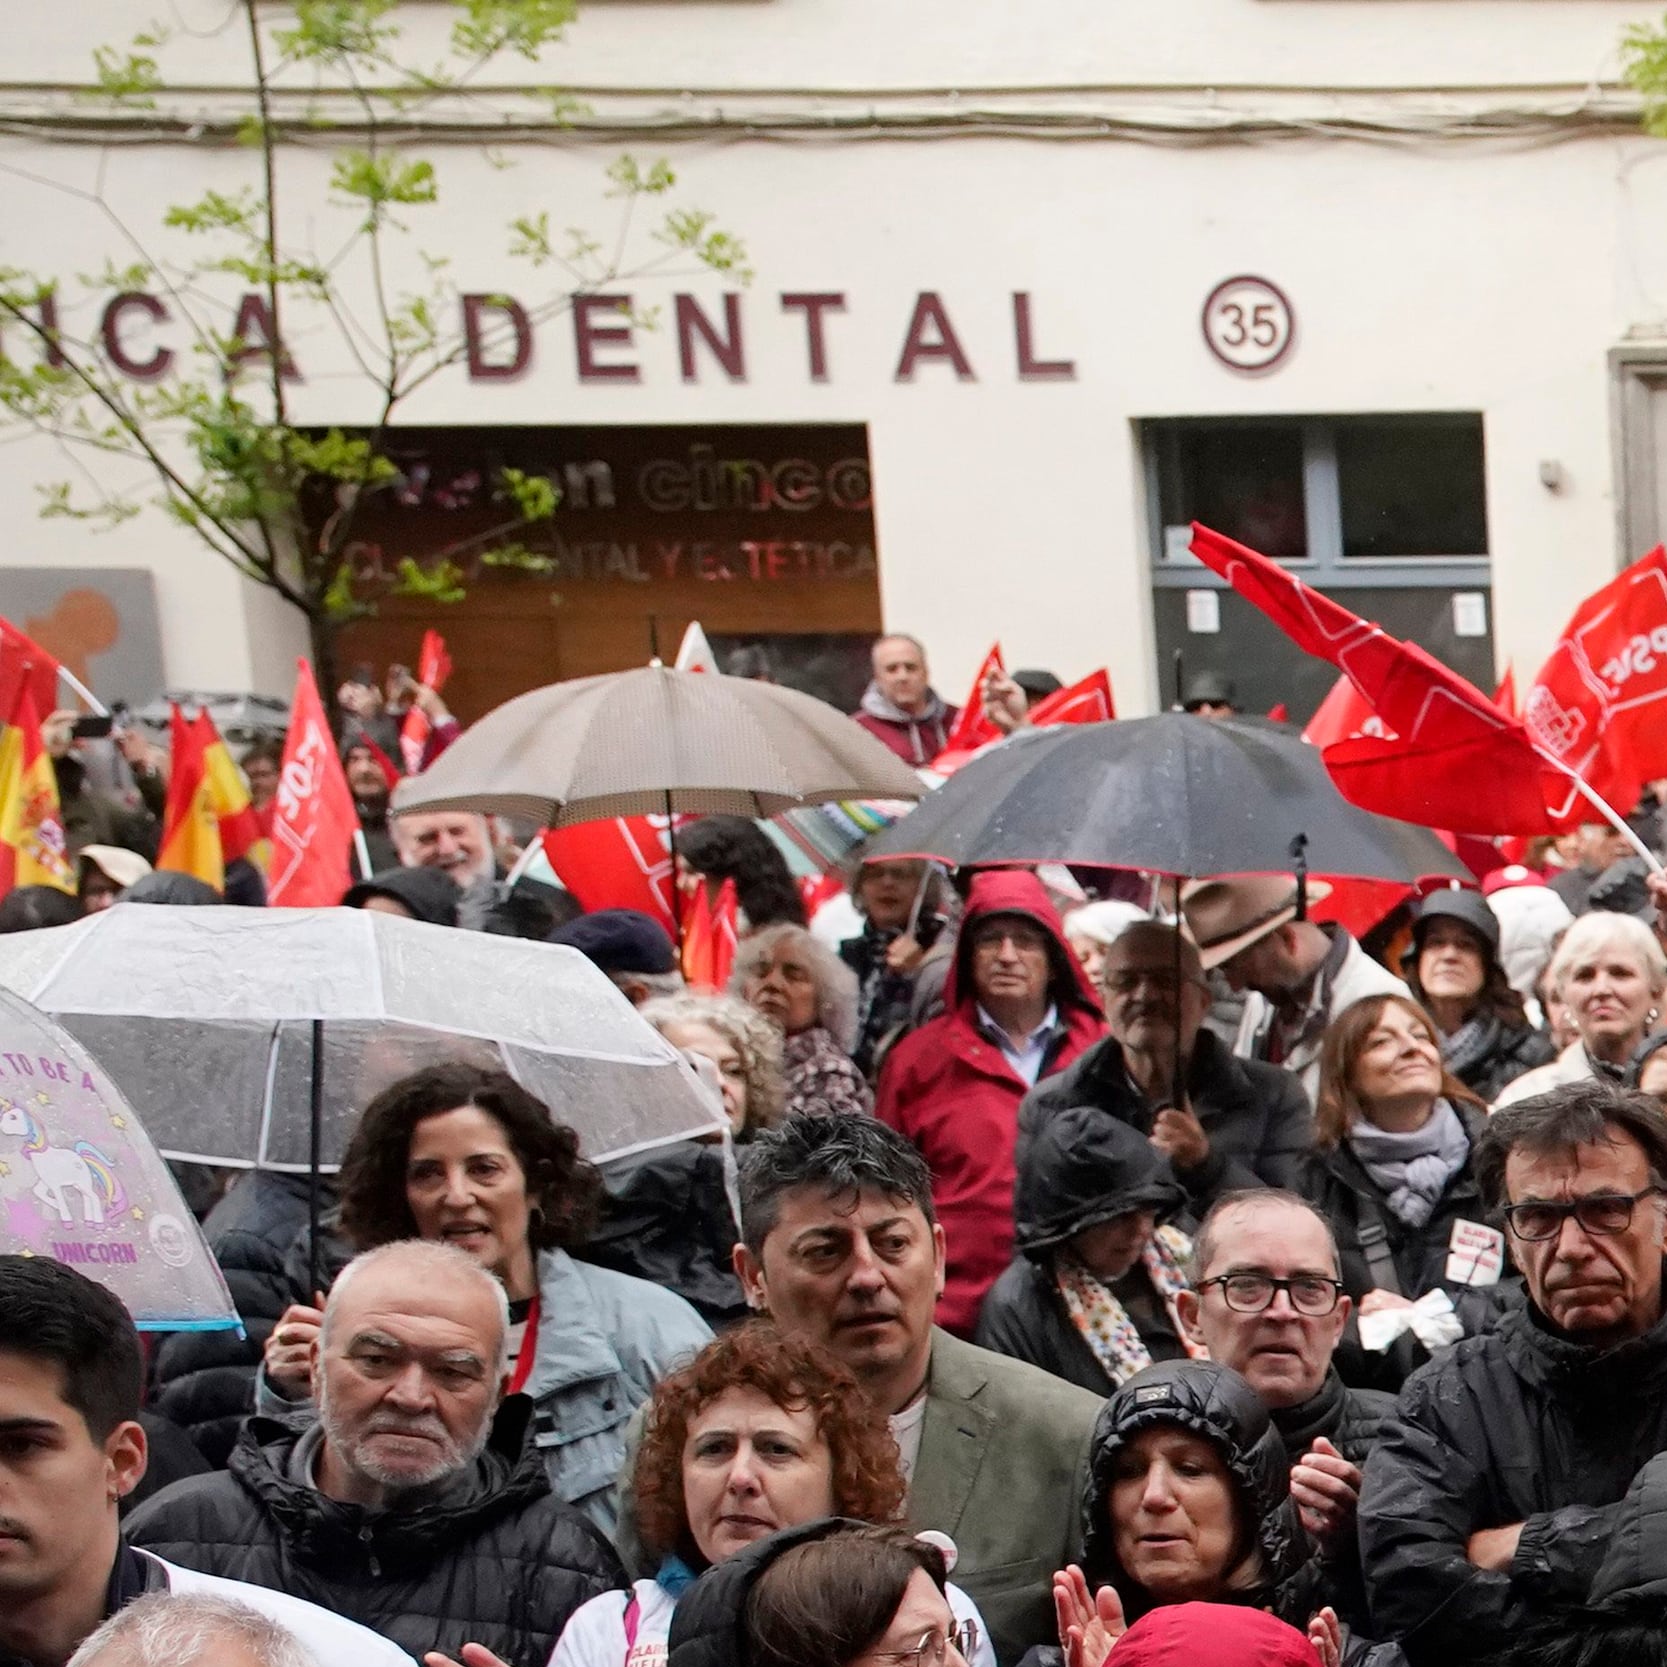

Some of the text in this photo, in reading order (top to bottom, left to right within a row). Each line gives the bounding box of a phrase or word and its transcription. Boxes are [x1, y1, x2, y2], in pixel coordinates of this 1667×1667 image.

[463, 292, 1077, 382] DENTAL
[1219, 302, 1279, 349] 35
[3, 1053, 97, 1092] TO BE A
[53, 1242, 138, 1264] UNICORN
